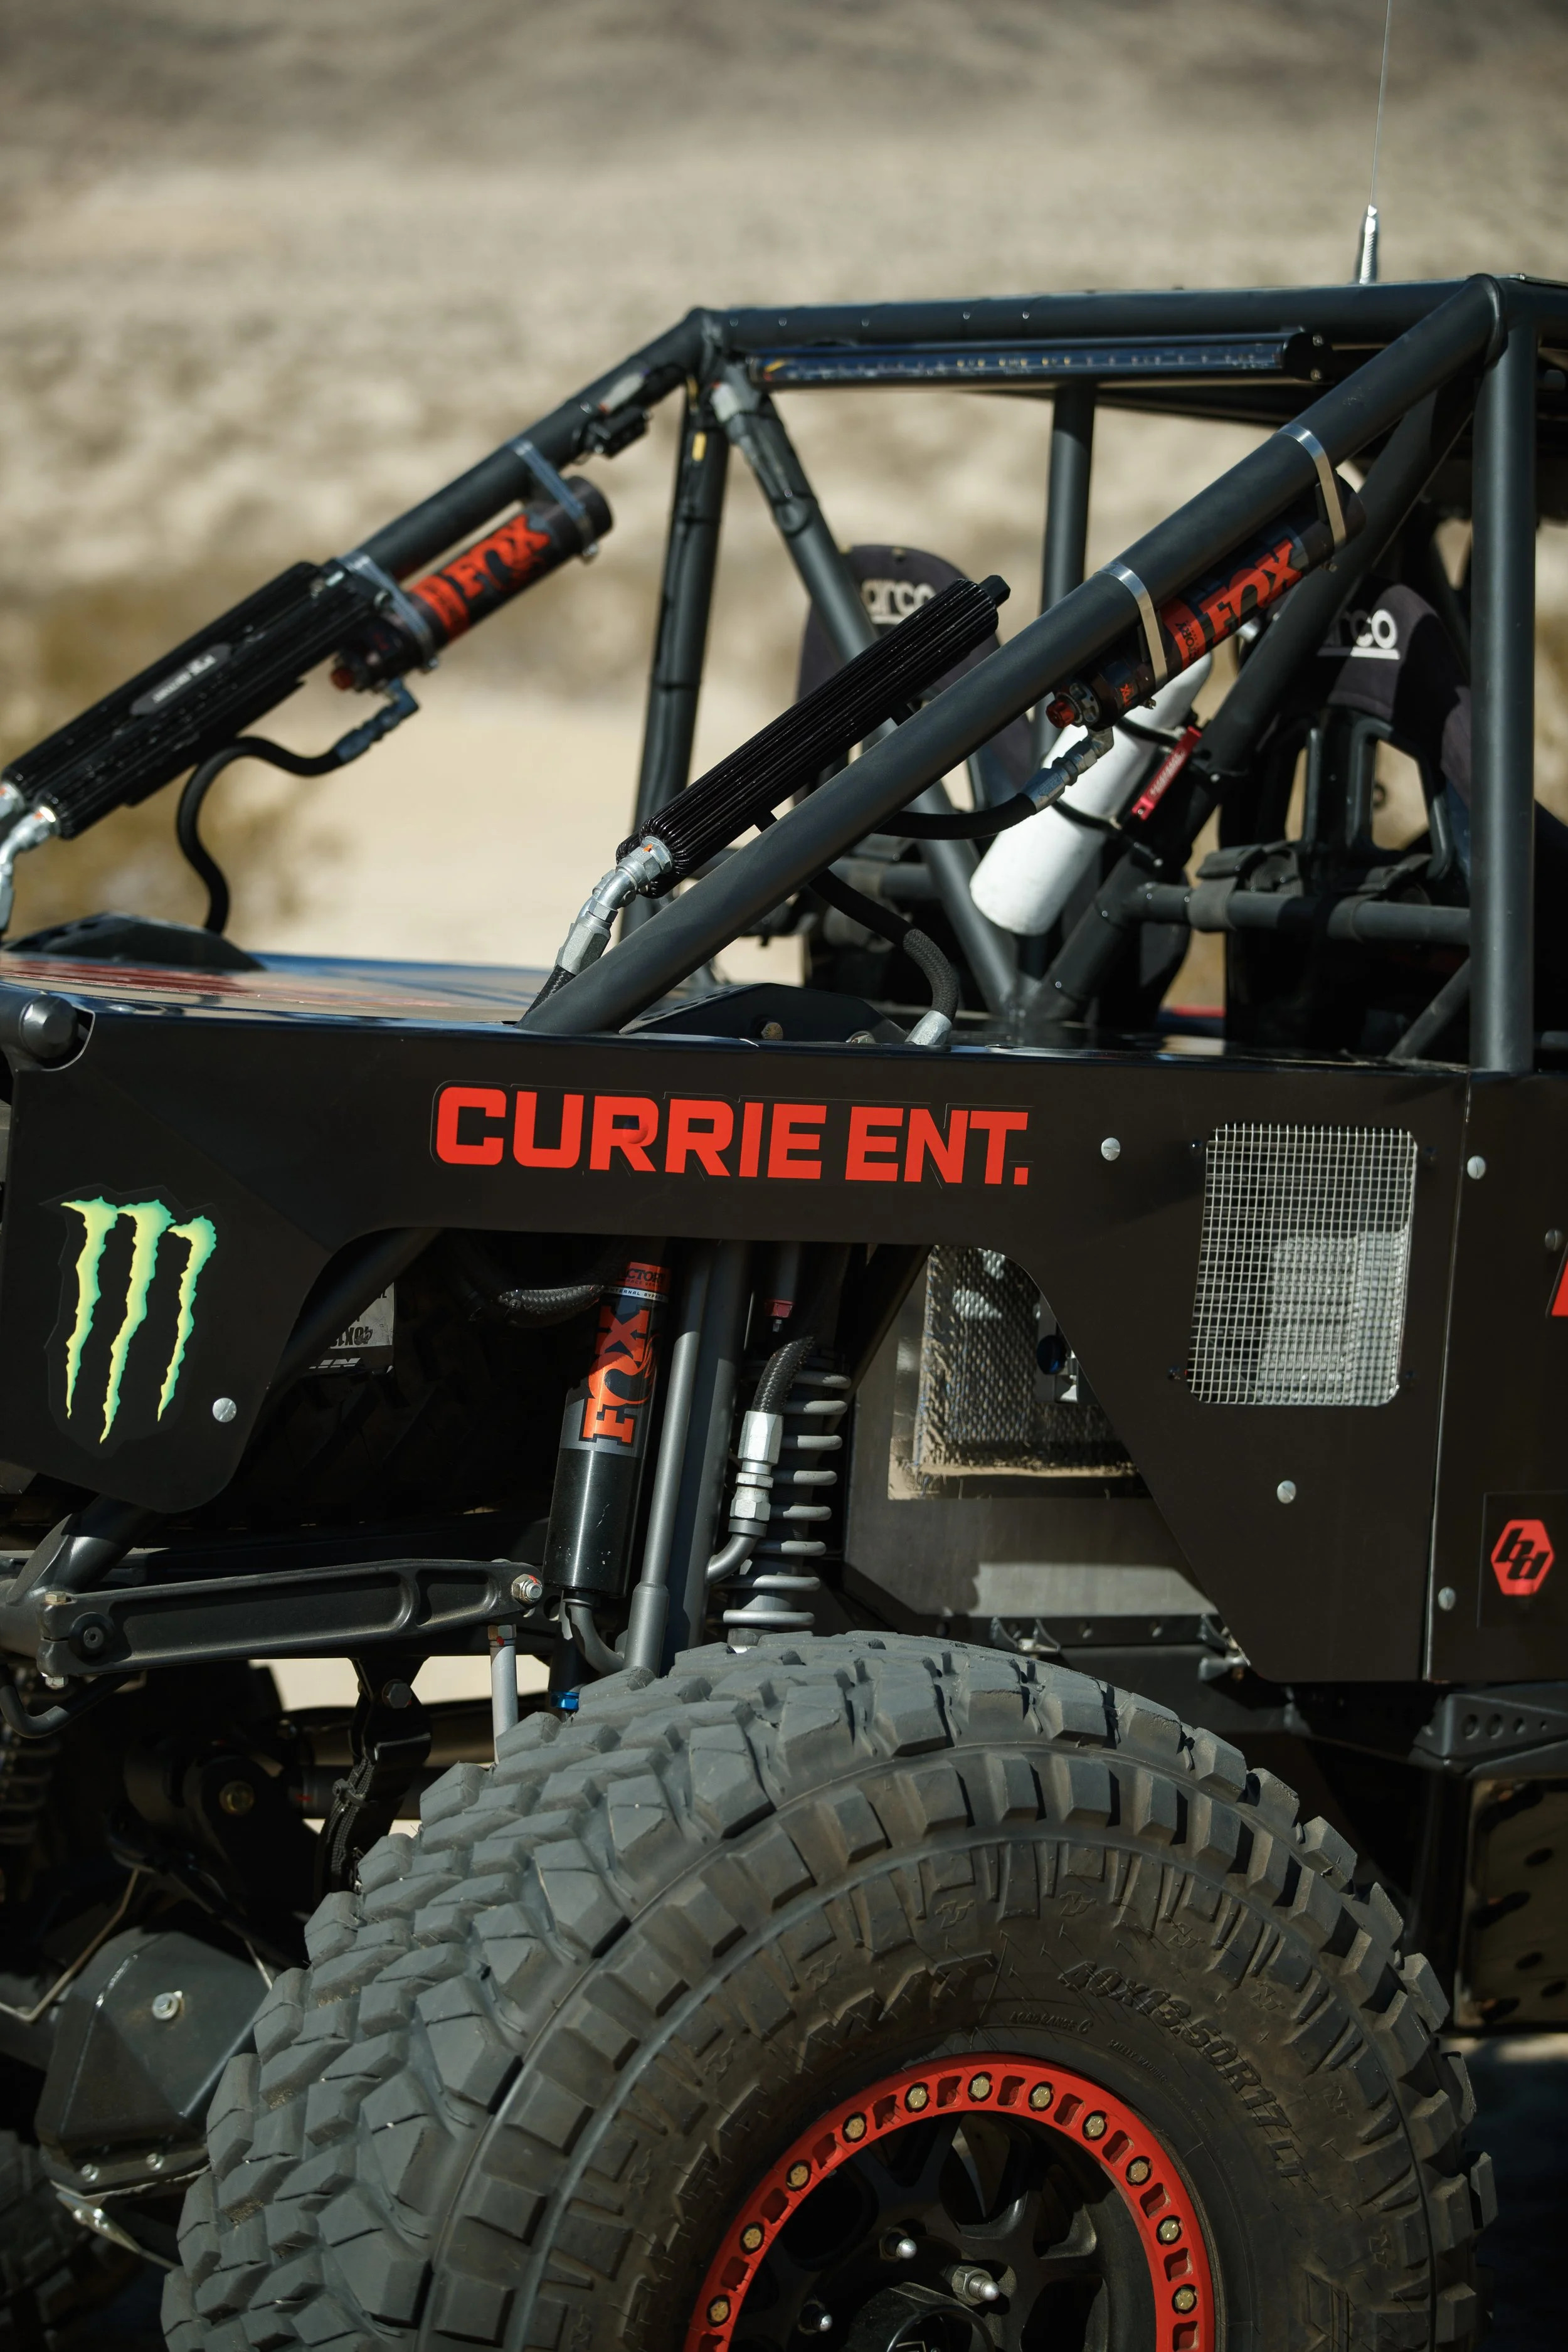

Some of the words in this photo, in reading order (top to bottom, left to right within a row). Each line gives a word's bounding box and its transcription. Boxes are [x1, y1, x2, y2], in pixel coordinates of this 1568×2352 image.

[441, 514, 550, 600] FOX
[861, 578, 936, 617] arco
[1199, 538, 1303, 644] FOX
[435, 1086, 827, 1180] CURRIE
[845, 1105, 1029, 1185] ENT.
[583, 1305, 657, 1443] FOX
